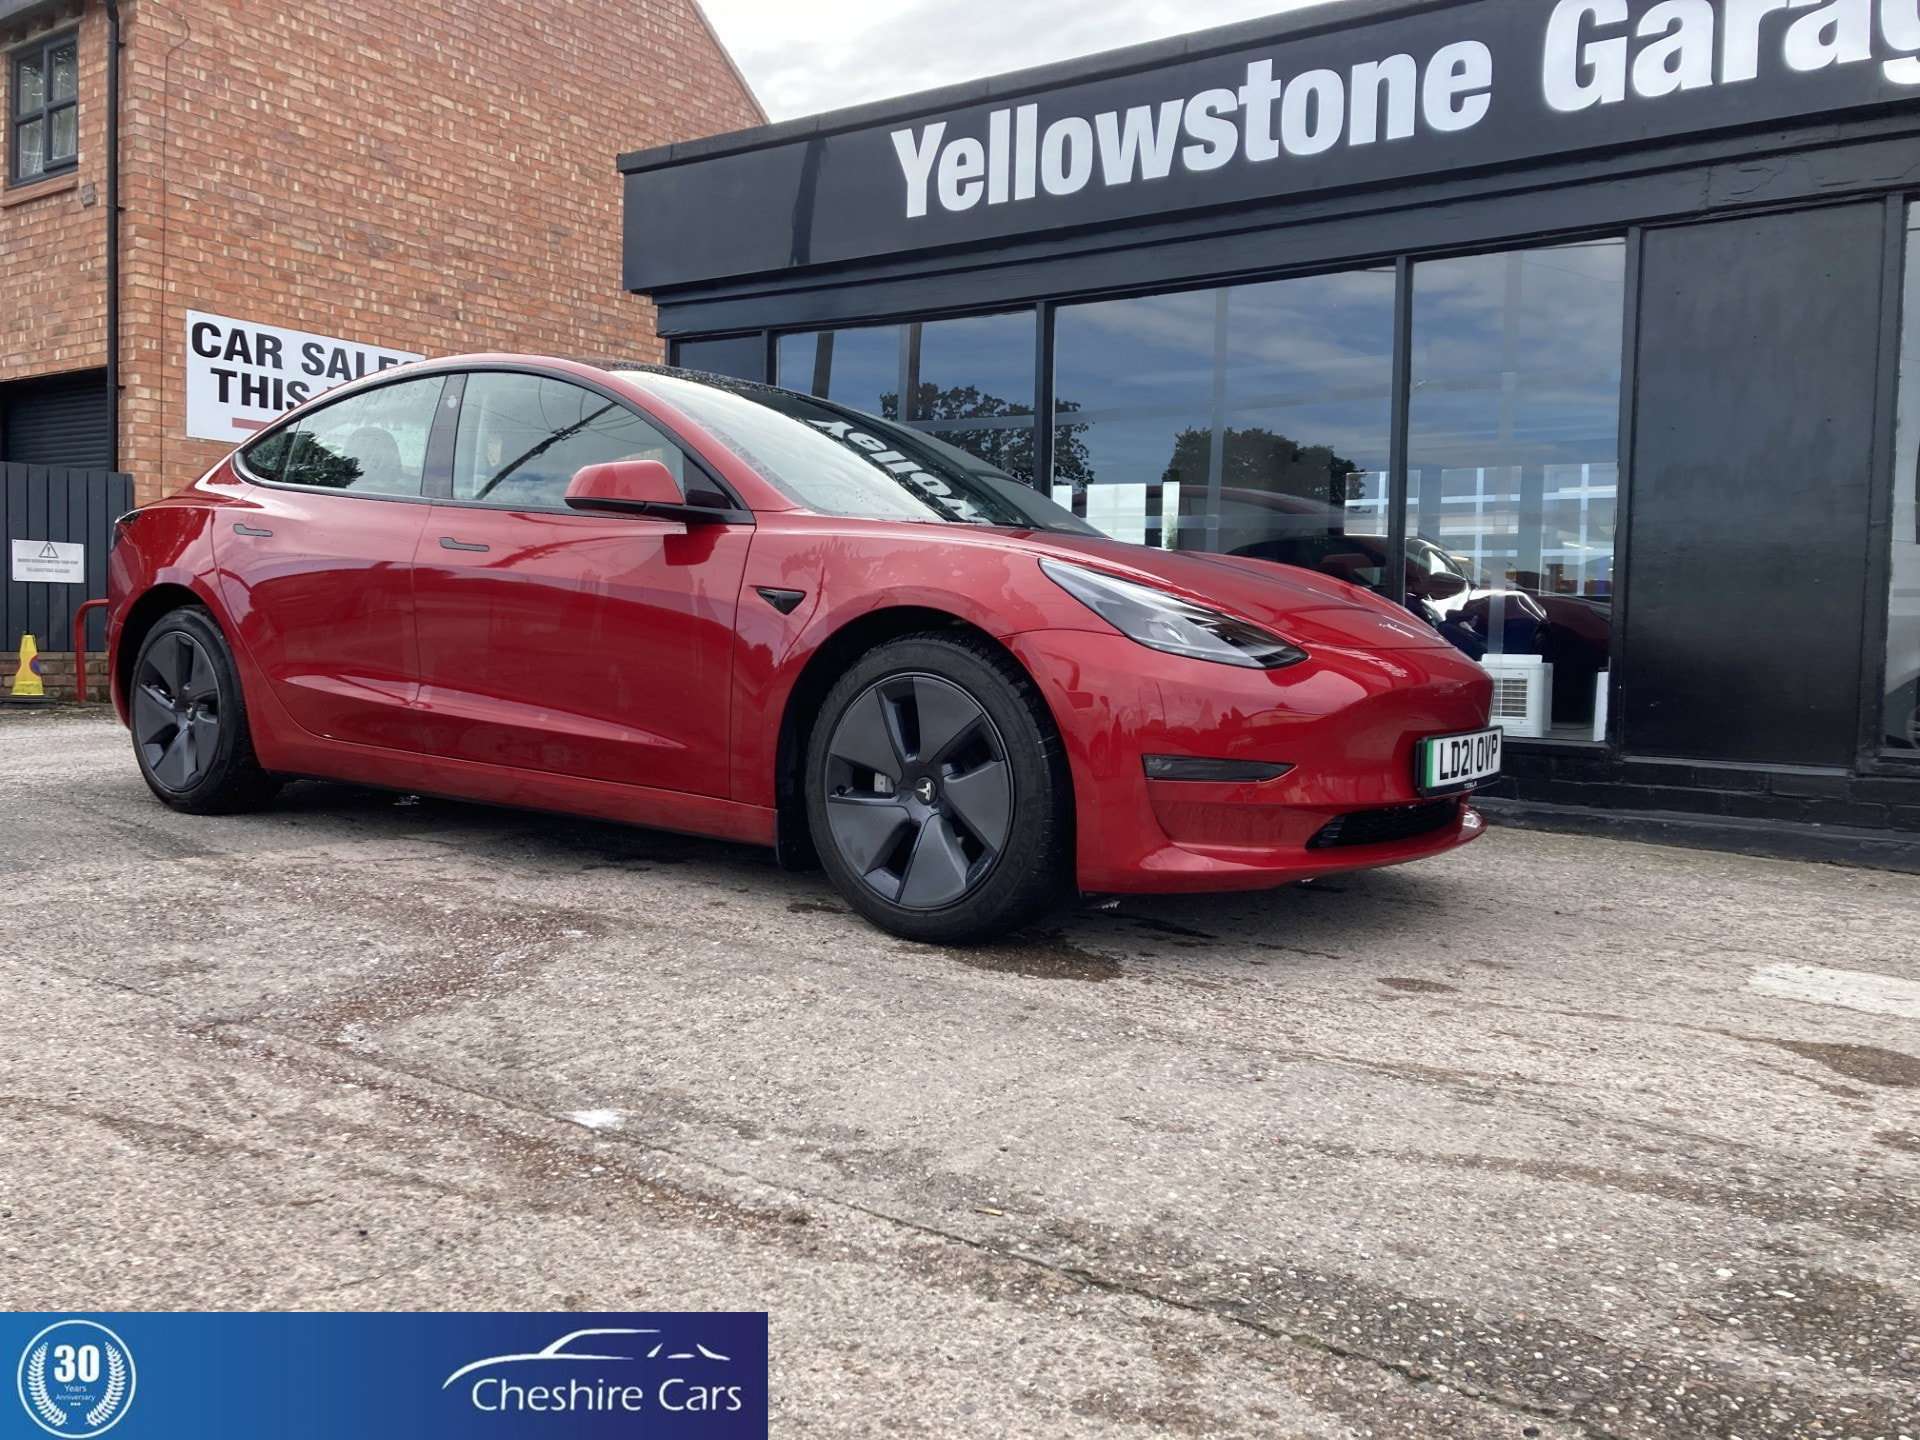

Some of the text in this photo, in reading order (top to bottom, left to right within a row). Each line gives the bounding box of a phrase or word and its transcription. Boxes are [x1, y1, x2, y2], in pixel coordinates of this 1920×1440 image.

[890, 40, 1493, 219] Yellowstone
[191, 321, 416, 382] CAR SAL
[1439, 733, 1499, 780] LD21 OVP
